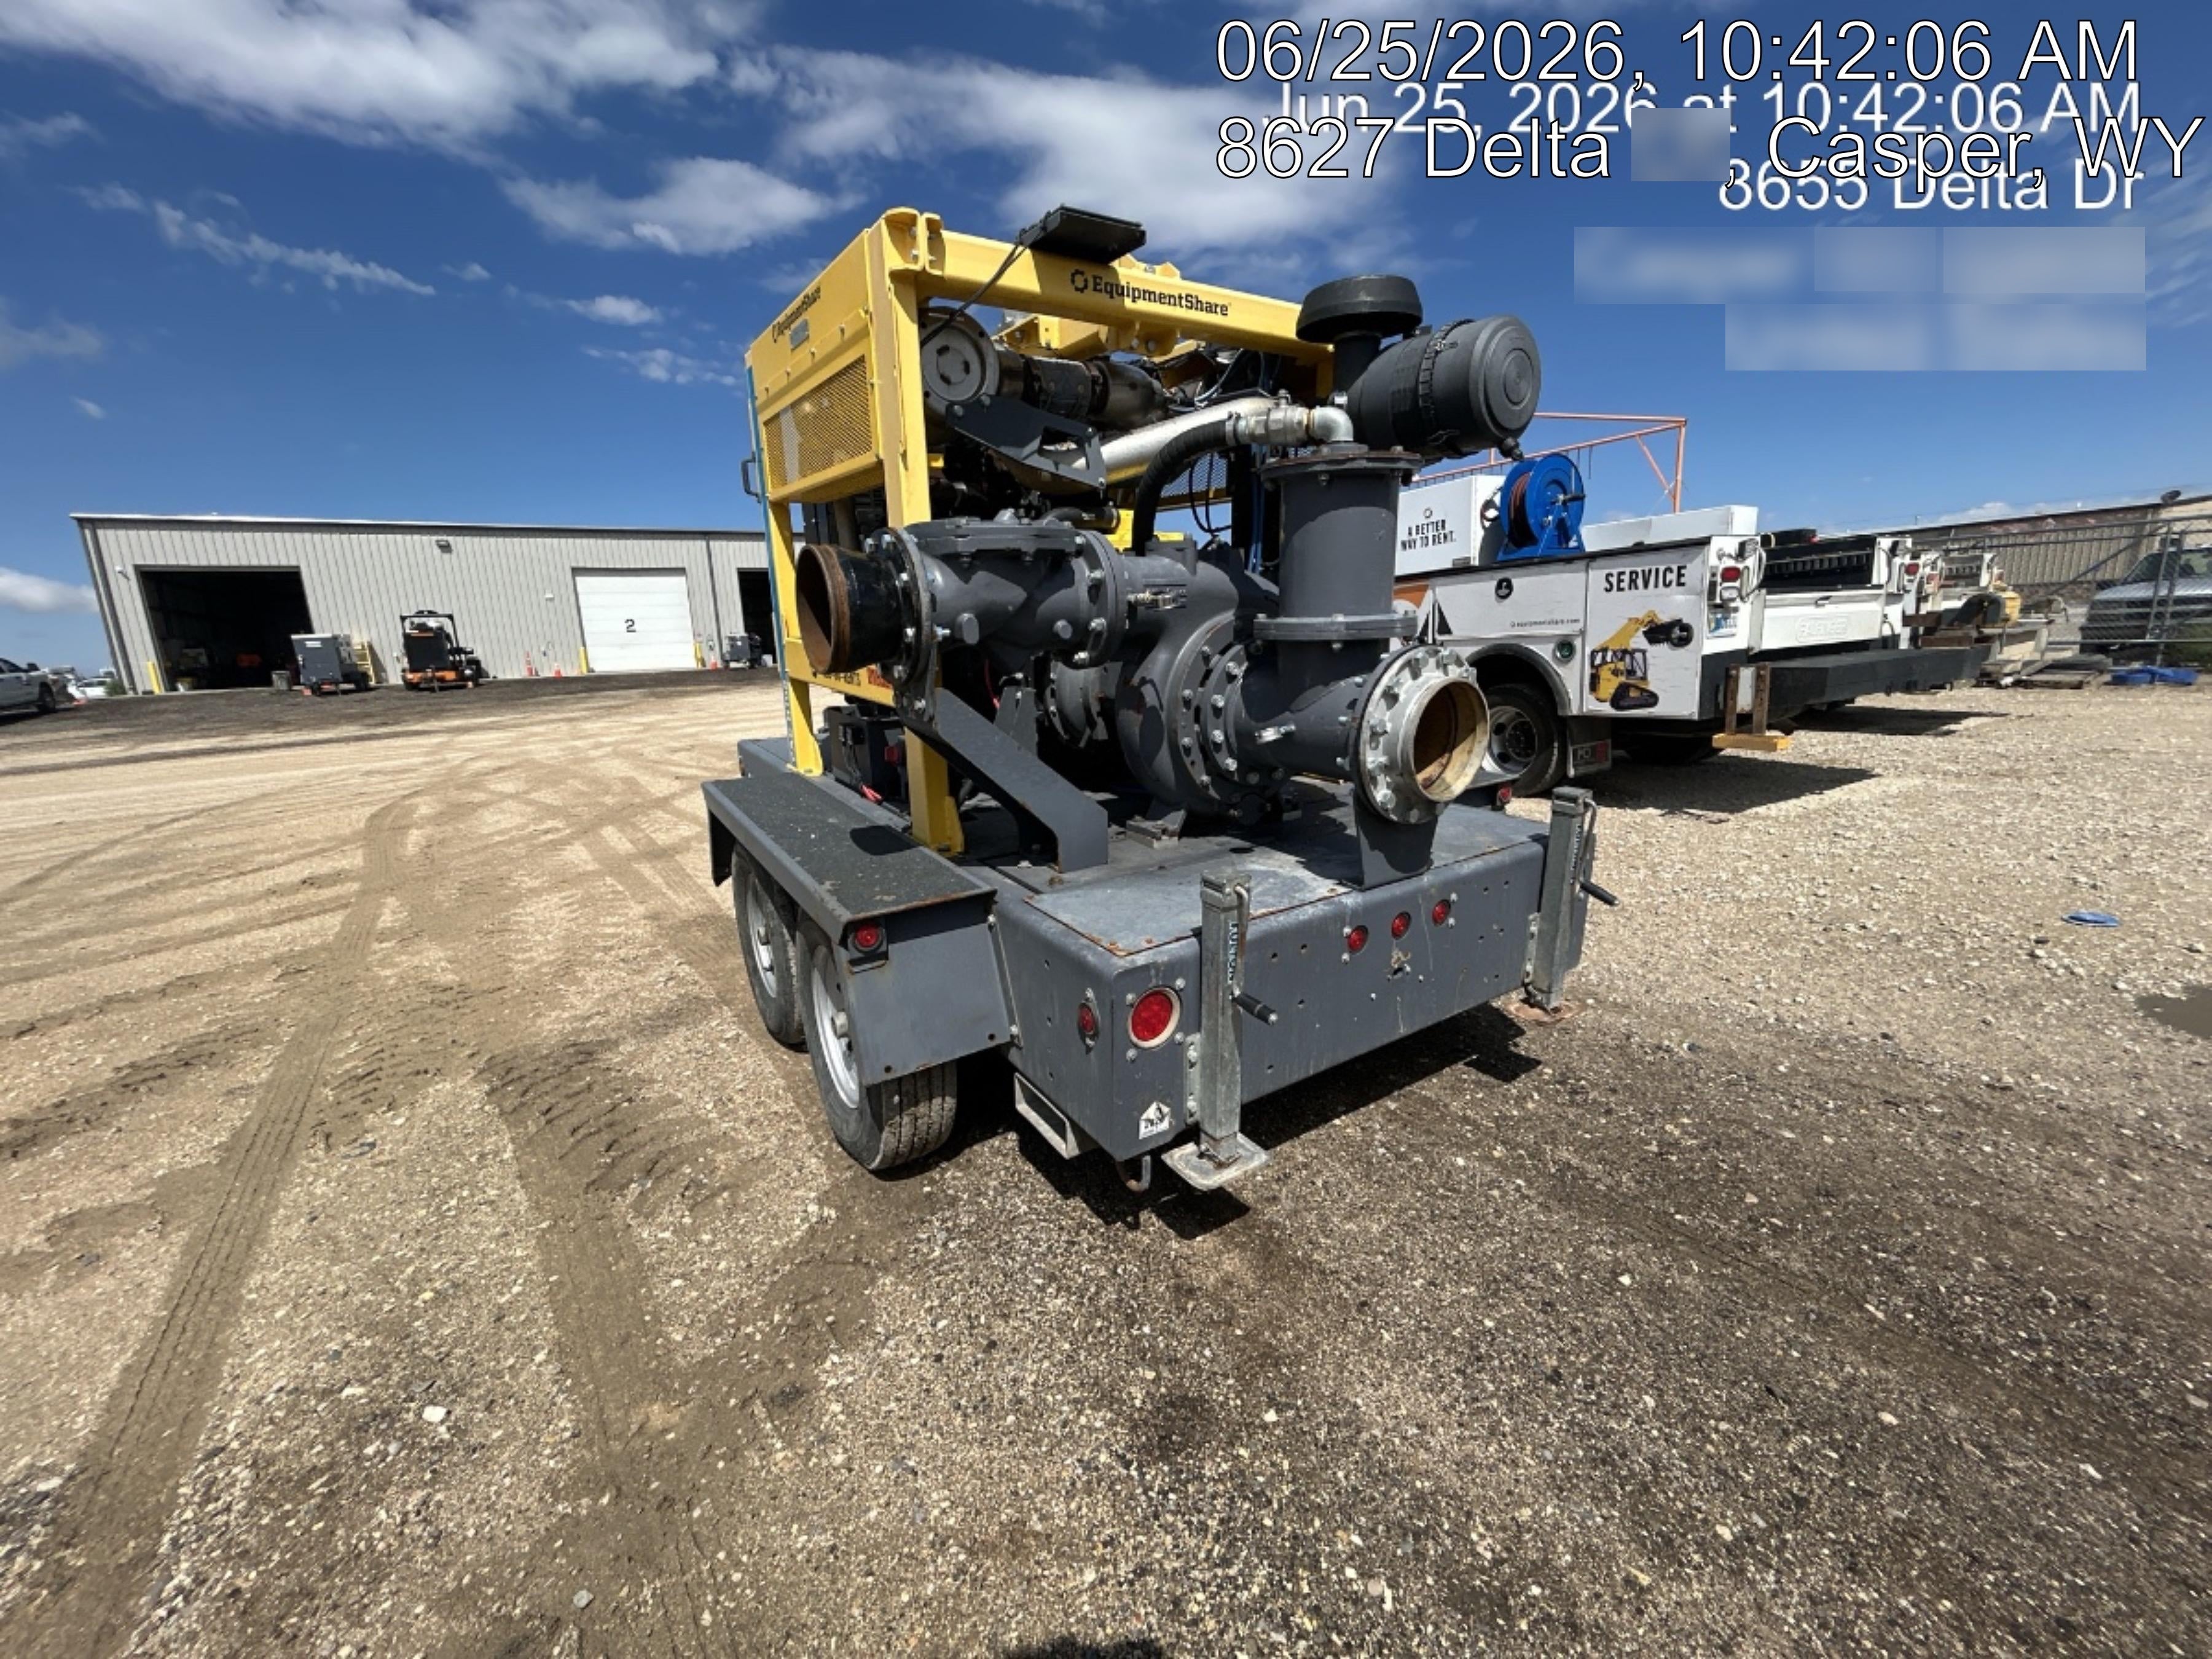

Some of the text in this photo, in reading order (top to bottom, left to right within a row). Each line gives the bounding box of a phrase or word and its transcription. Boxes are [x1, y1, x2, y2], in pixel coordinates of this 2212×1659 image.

[1092, 274, 1229, 316] EquipmentShare
[1408, 519, 1446, 537] A BETTER
[1400, 530, 1457, 552] WAY TO RENT.
[1603, 565, 1688, 593] SERVICE
[624, 619, 637, 633] 2
